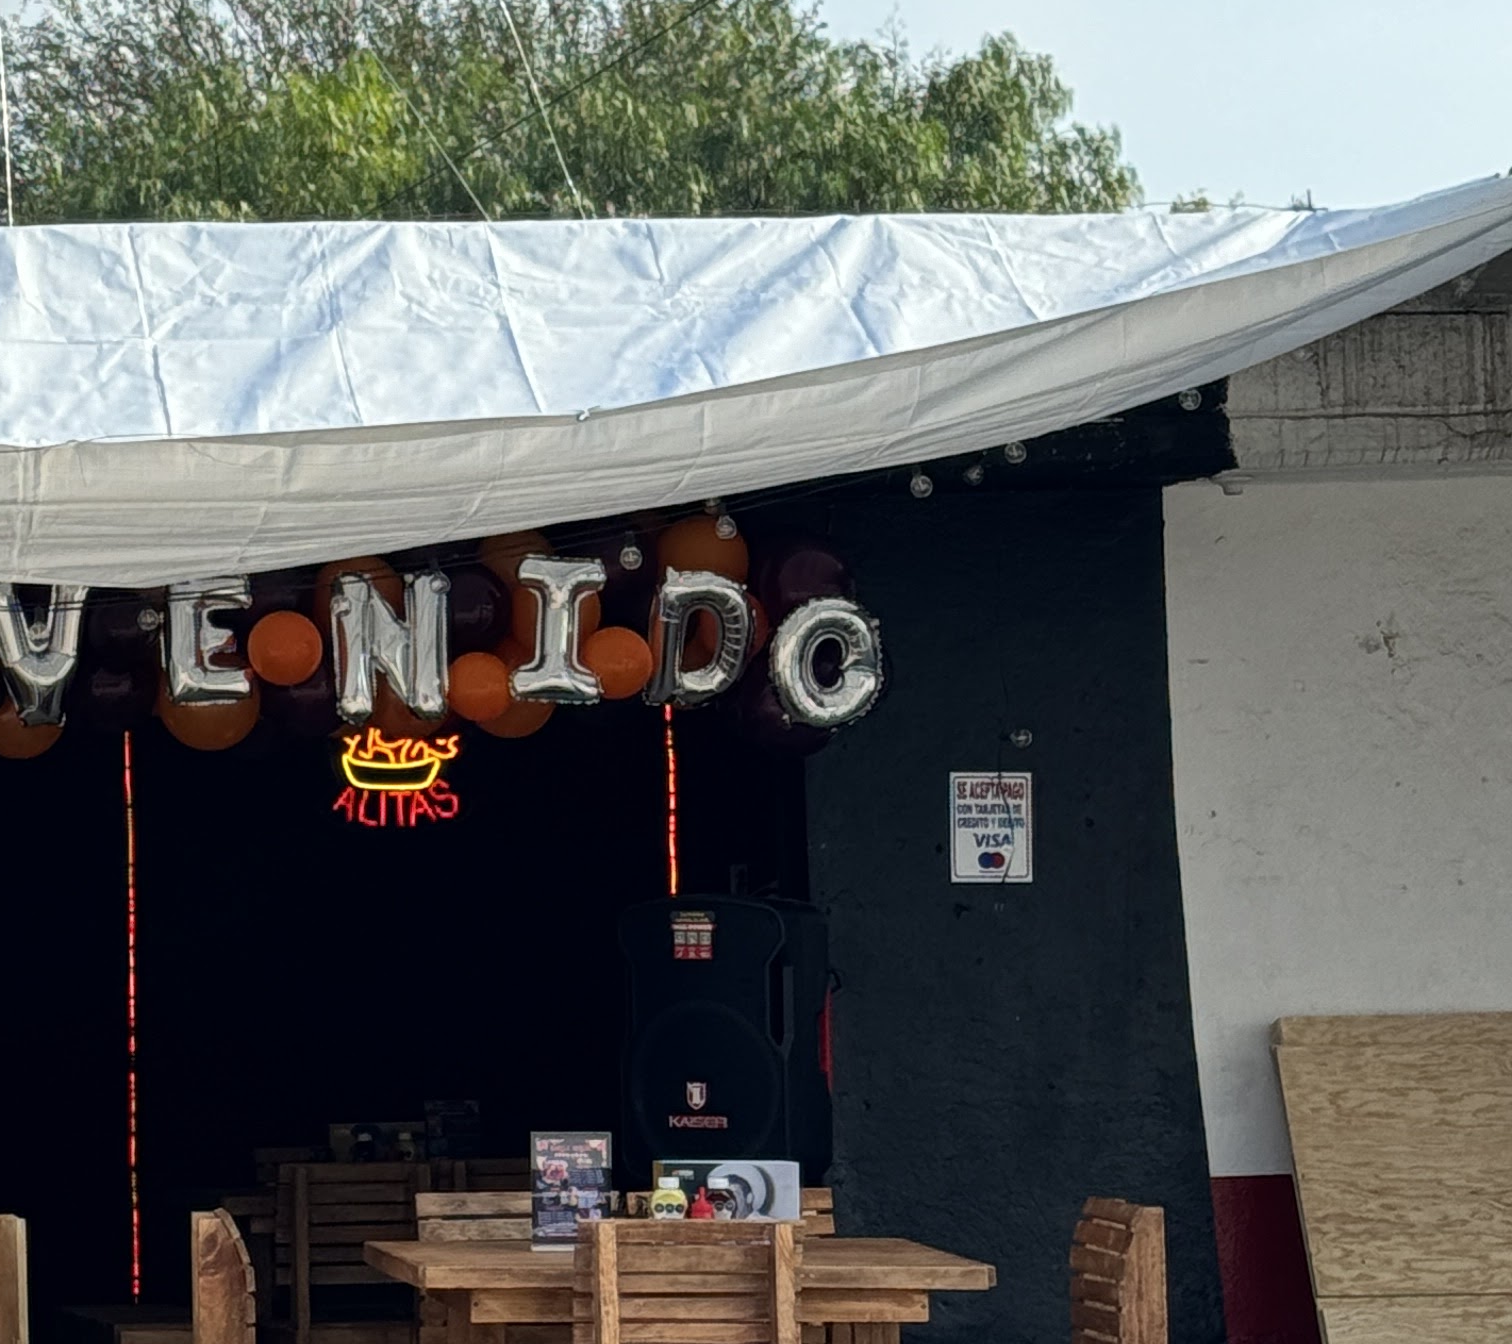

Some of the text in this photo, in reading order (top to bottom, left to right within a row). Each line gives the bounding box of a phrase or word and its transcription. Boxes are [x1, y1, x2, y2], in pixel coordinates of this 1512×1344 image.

[332, 778, 459, 827] ALITAS
[973, 833, 1012, 848] VISA
[668, 1115, 729, 1129] KAISER
